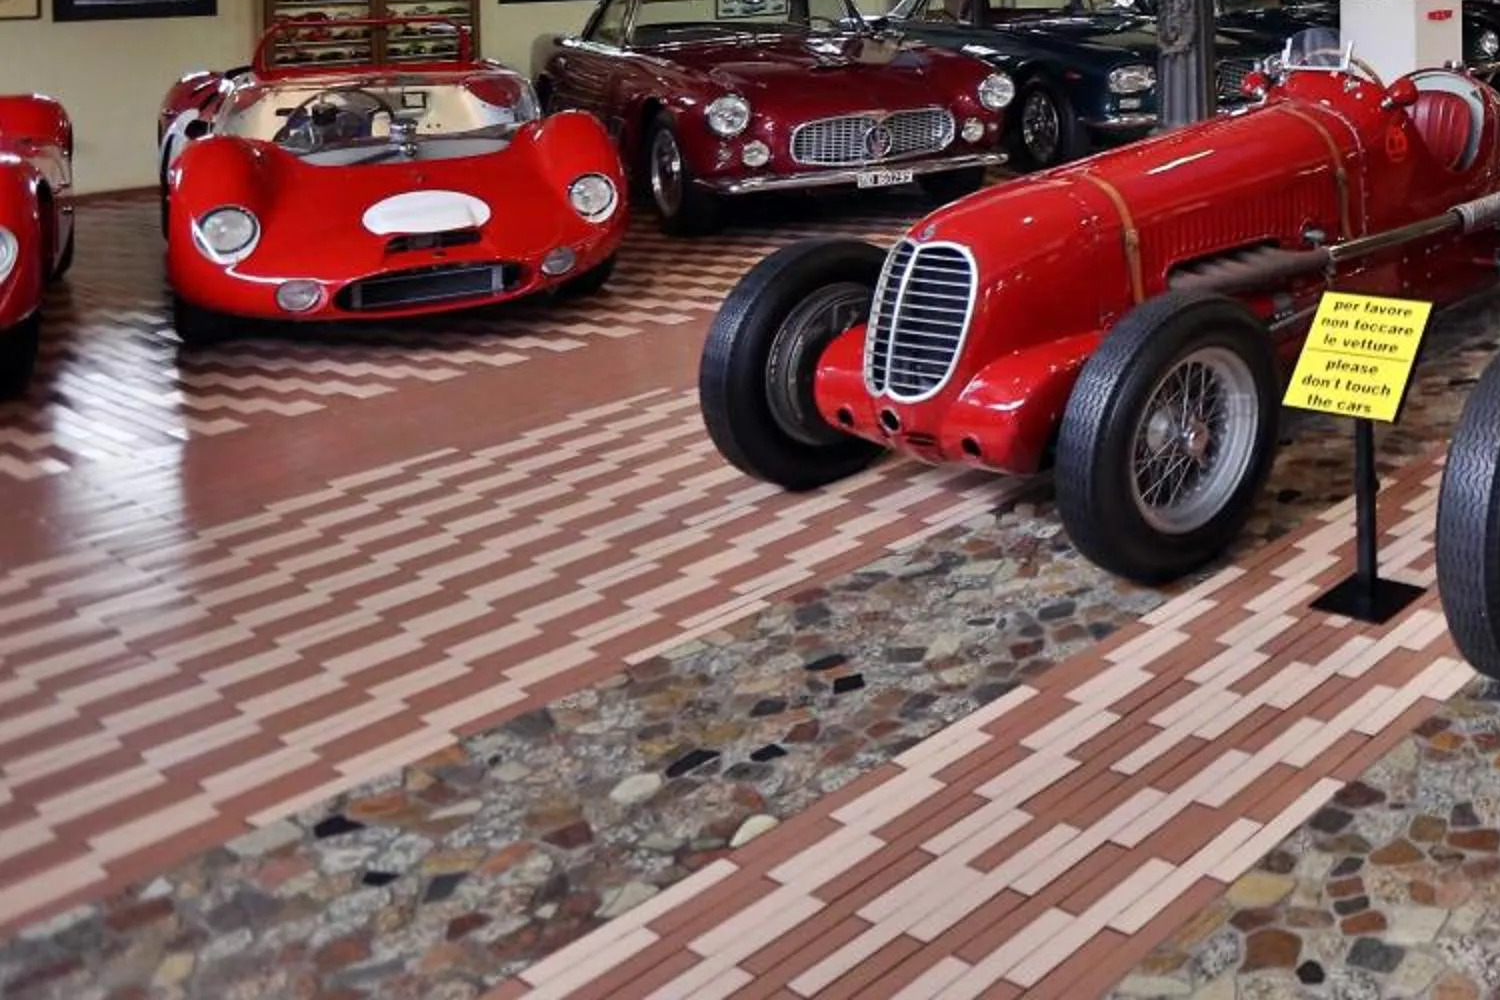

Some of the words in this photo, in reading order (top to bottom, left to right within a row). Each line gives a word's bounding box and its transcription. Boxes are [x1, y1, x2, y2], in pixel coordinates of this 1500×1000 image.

[1333, 300, 1361, 312] per
[1364, 301, 1414, 317] favore
[1320, 317, 1349, 329] non
[1353, 319, 1415, 337] toccare
[1323, 333, 1337, 345] le
[1342, 337, 1399, 353] vetture
[1325, 358, 1379, 375] please
[1345, 379, 1392, 397] touch
[1306, 393, 1332, 407] the
[1336, 399, 1372, 413] cars
